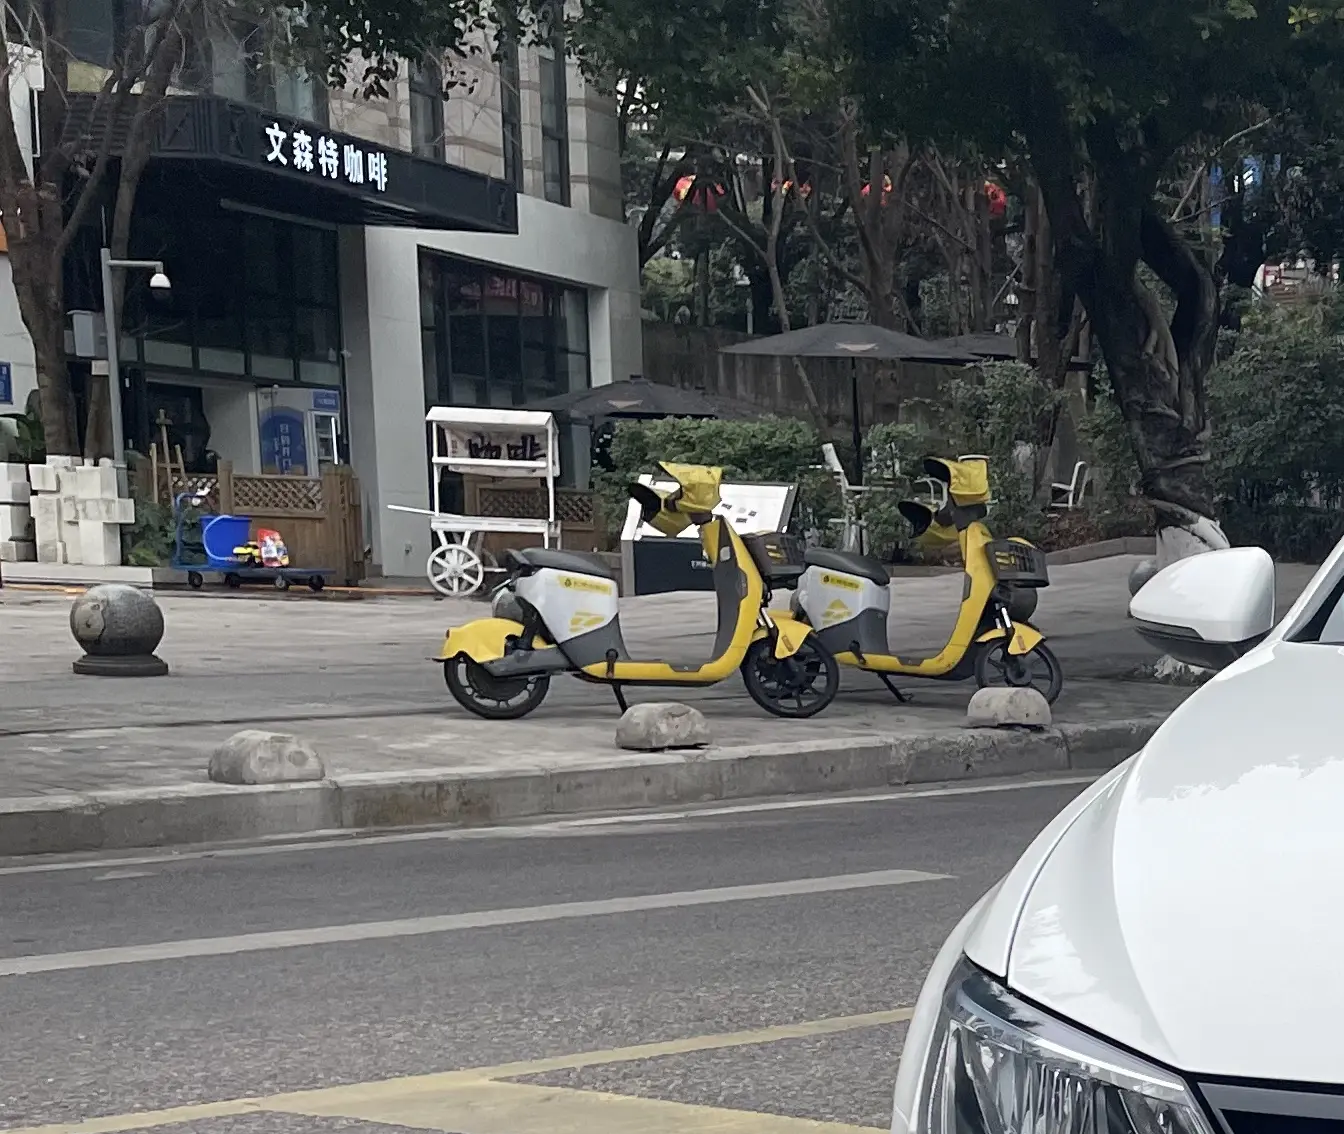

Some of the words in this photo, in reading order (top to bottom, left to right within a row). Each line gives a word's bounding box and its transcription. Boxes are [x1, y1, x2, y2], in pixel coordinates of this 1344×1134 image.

[265, 122, 388, 192] 文森特咖啡
